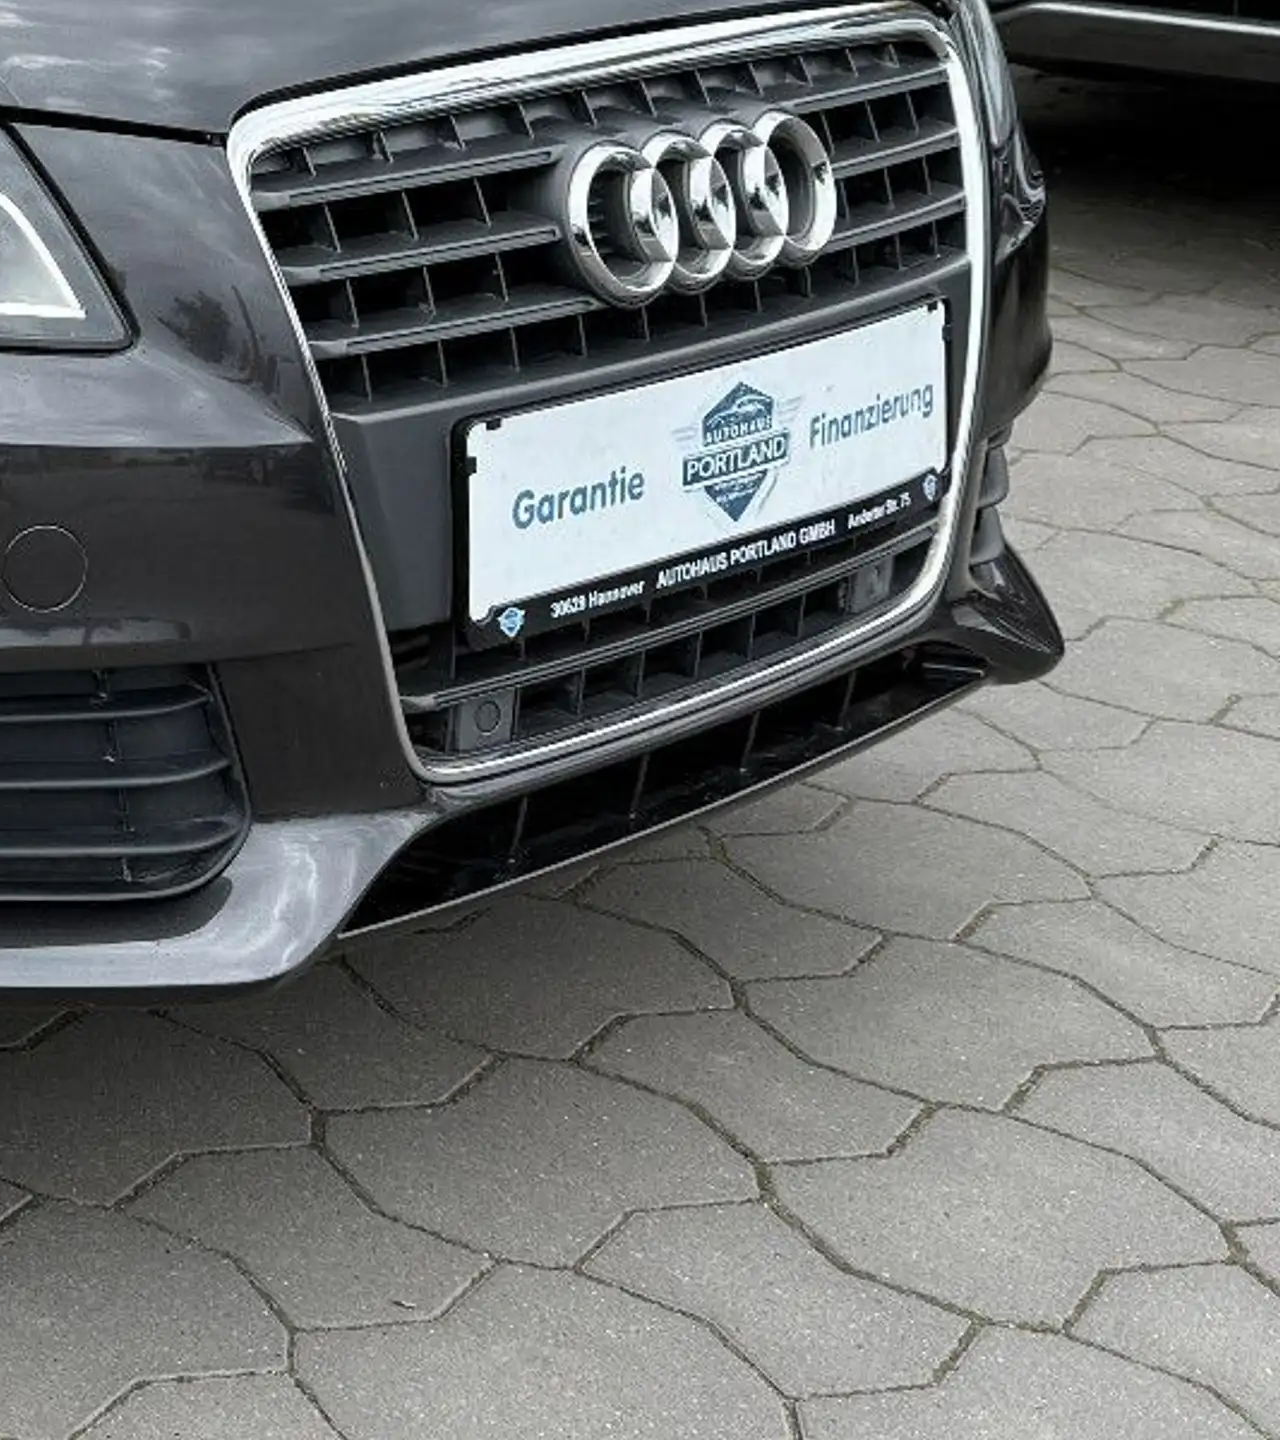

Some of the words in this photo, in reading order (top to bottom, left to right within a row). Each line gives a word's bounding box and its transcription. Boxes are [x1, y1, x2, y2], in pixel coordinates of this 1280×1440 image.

[705, 415, 772, 444] AUTOHAUS
[809, 384, 934, 449] Finanzierung
[687, 436, 785, 481] PORTLAND
[512, 465, 645, 529] Garantie
[589, 580, 646, 609] Hannover
[655, 551, 729, 590] AUTOHAUS
[730, 532, 797, 565] PORTLAND
[799, 519, 837, 545] GMBH
